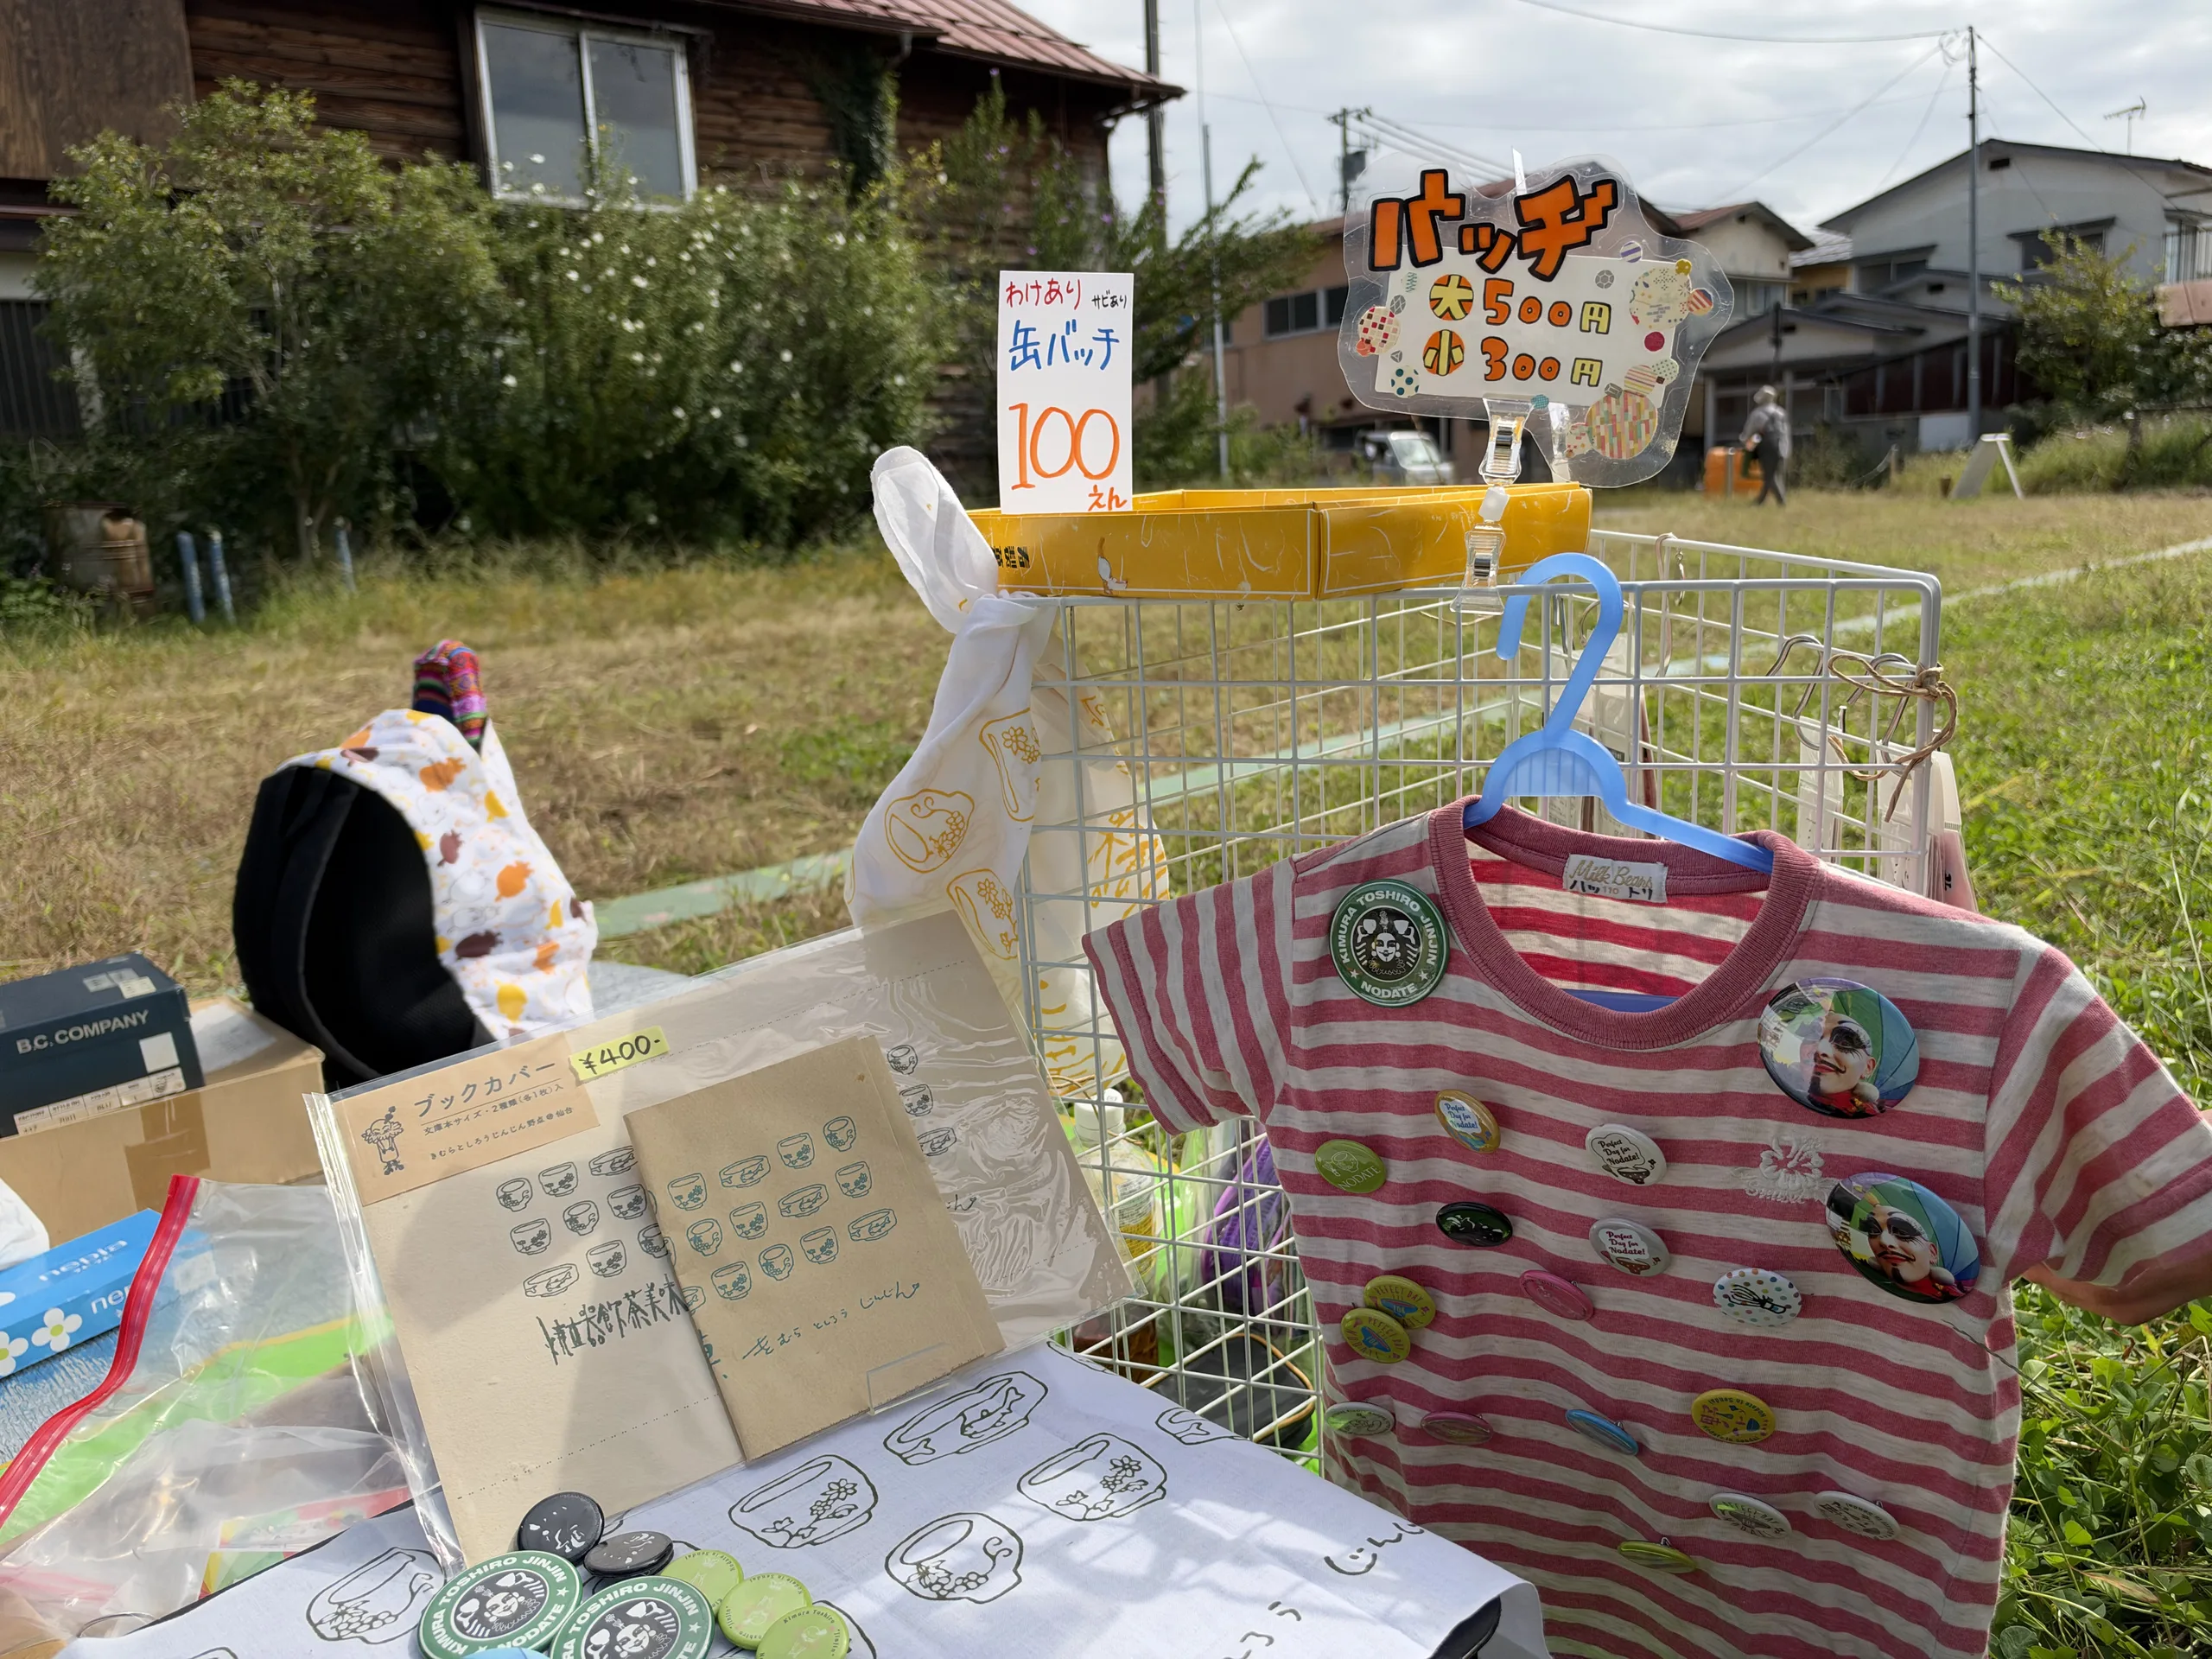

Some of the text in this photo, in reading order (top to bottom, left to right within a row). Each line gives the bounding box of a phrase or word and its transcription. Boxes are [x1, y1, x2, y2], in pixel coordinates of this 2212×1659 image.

[1006, 277, 1127, 310] わけあり サビあり
[1431, 273, 1611, 334] 大 500円
[1008, 319, 1120, 371] 缶バッチ
[1423, 329, 1603, 387] 小 300円
[1008, 403, 1120, 490] 100
[1088, 484, 1128, 512] えん
[1569, 860, 1611, 884] Milk
[1338, 890, 1438, 966] KIMURA TOSHIRO JINJIN
[1360, 981, 1418, 999] NODATE
[54, 1009, 149, 1046] COMPANY
[414, 1062, 556, 1118] ブックカバー
[1598, 1139, 1623, 1148] Perfect
[1606, 1152, 1640, 1166] Nodate!
[1338, 1165, 1381, 1192] NODATE
[1605, 1230, 1633, 1241] Perfect
[1609, 1247, 1646, 1255] Nodate!
[431, 1555, 568, 1655] KIMURA TOSHIRO JINJIN
[569, 1582, 700, 1634] TOSHIRO JINJIN
[783, 1610, 810, 1624] Kimura
[812, 1609, 836, 1624] Toshiro
